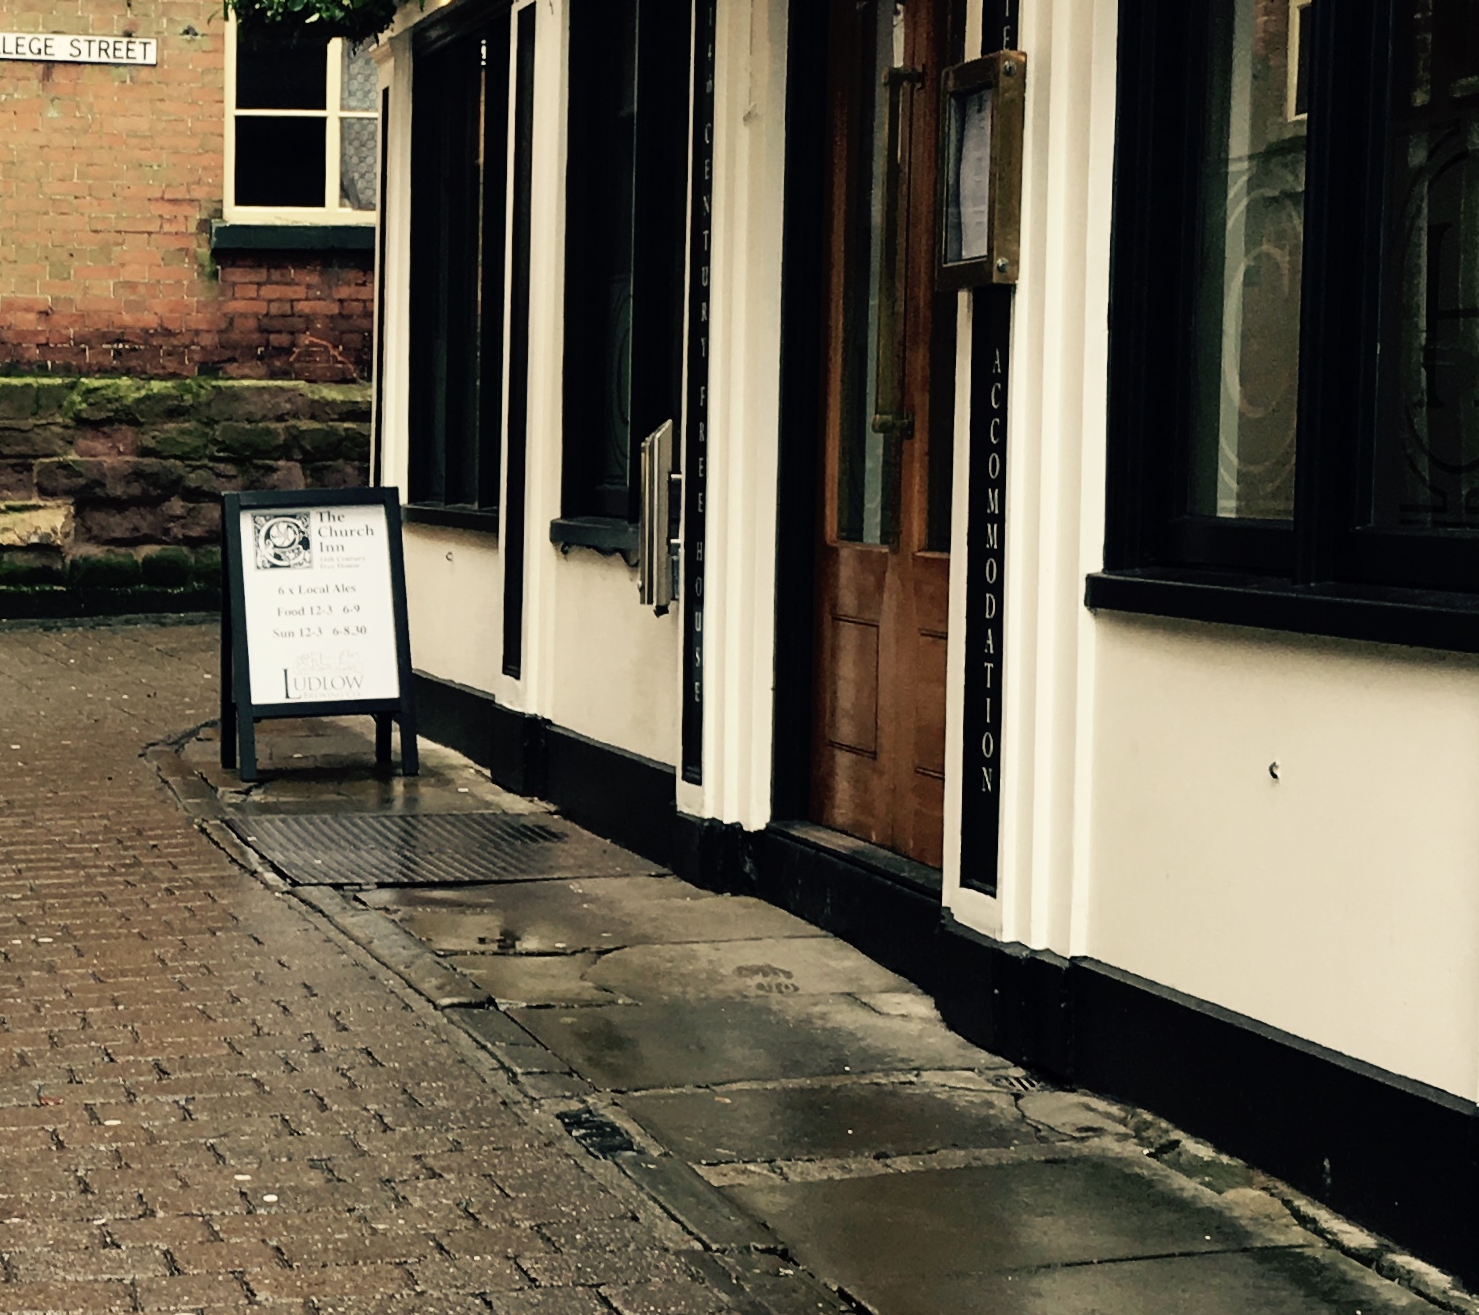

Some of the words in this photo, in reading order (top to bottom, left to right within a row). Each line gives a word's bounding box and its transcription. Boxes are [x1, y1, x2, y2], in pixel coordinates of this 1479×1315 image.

[69, 38, 152, 61] STREET
[700, 123, 712, 358] CENTURY
[697, 386, 706, 513] FREE
[316, 510, 345, 523] The
[318, 524, 375, 538] Church
[319, 541, 345, 553] Inn
[980, 347, 1003, 793] ACCOMMODATION
[278, 586, 284, 595] 6
[297, 583, 329, 595] Local
[332, 582, 357, 593] Ales
[277, 606, 305, 617] Food
[309, 605, 333, 616] 12-3
[342, 604, 361, 614] 6-9
[272, 628, 295, 638] Sun
[299, 627, 323, 637] 12-3
[332, 625, 367, 636] 6-8.30
[693, 542, 704, 703] HOUSE
[283, 668, 364, 699] LUDLOW
